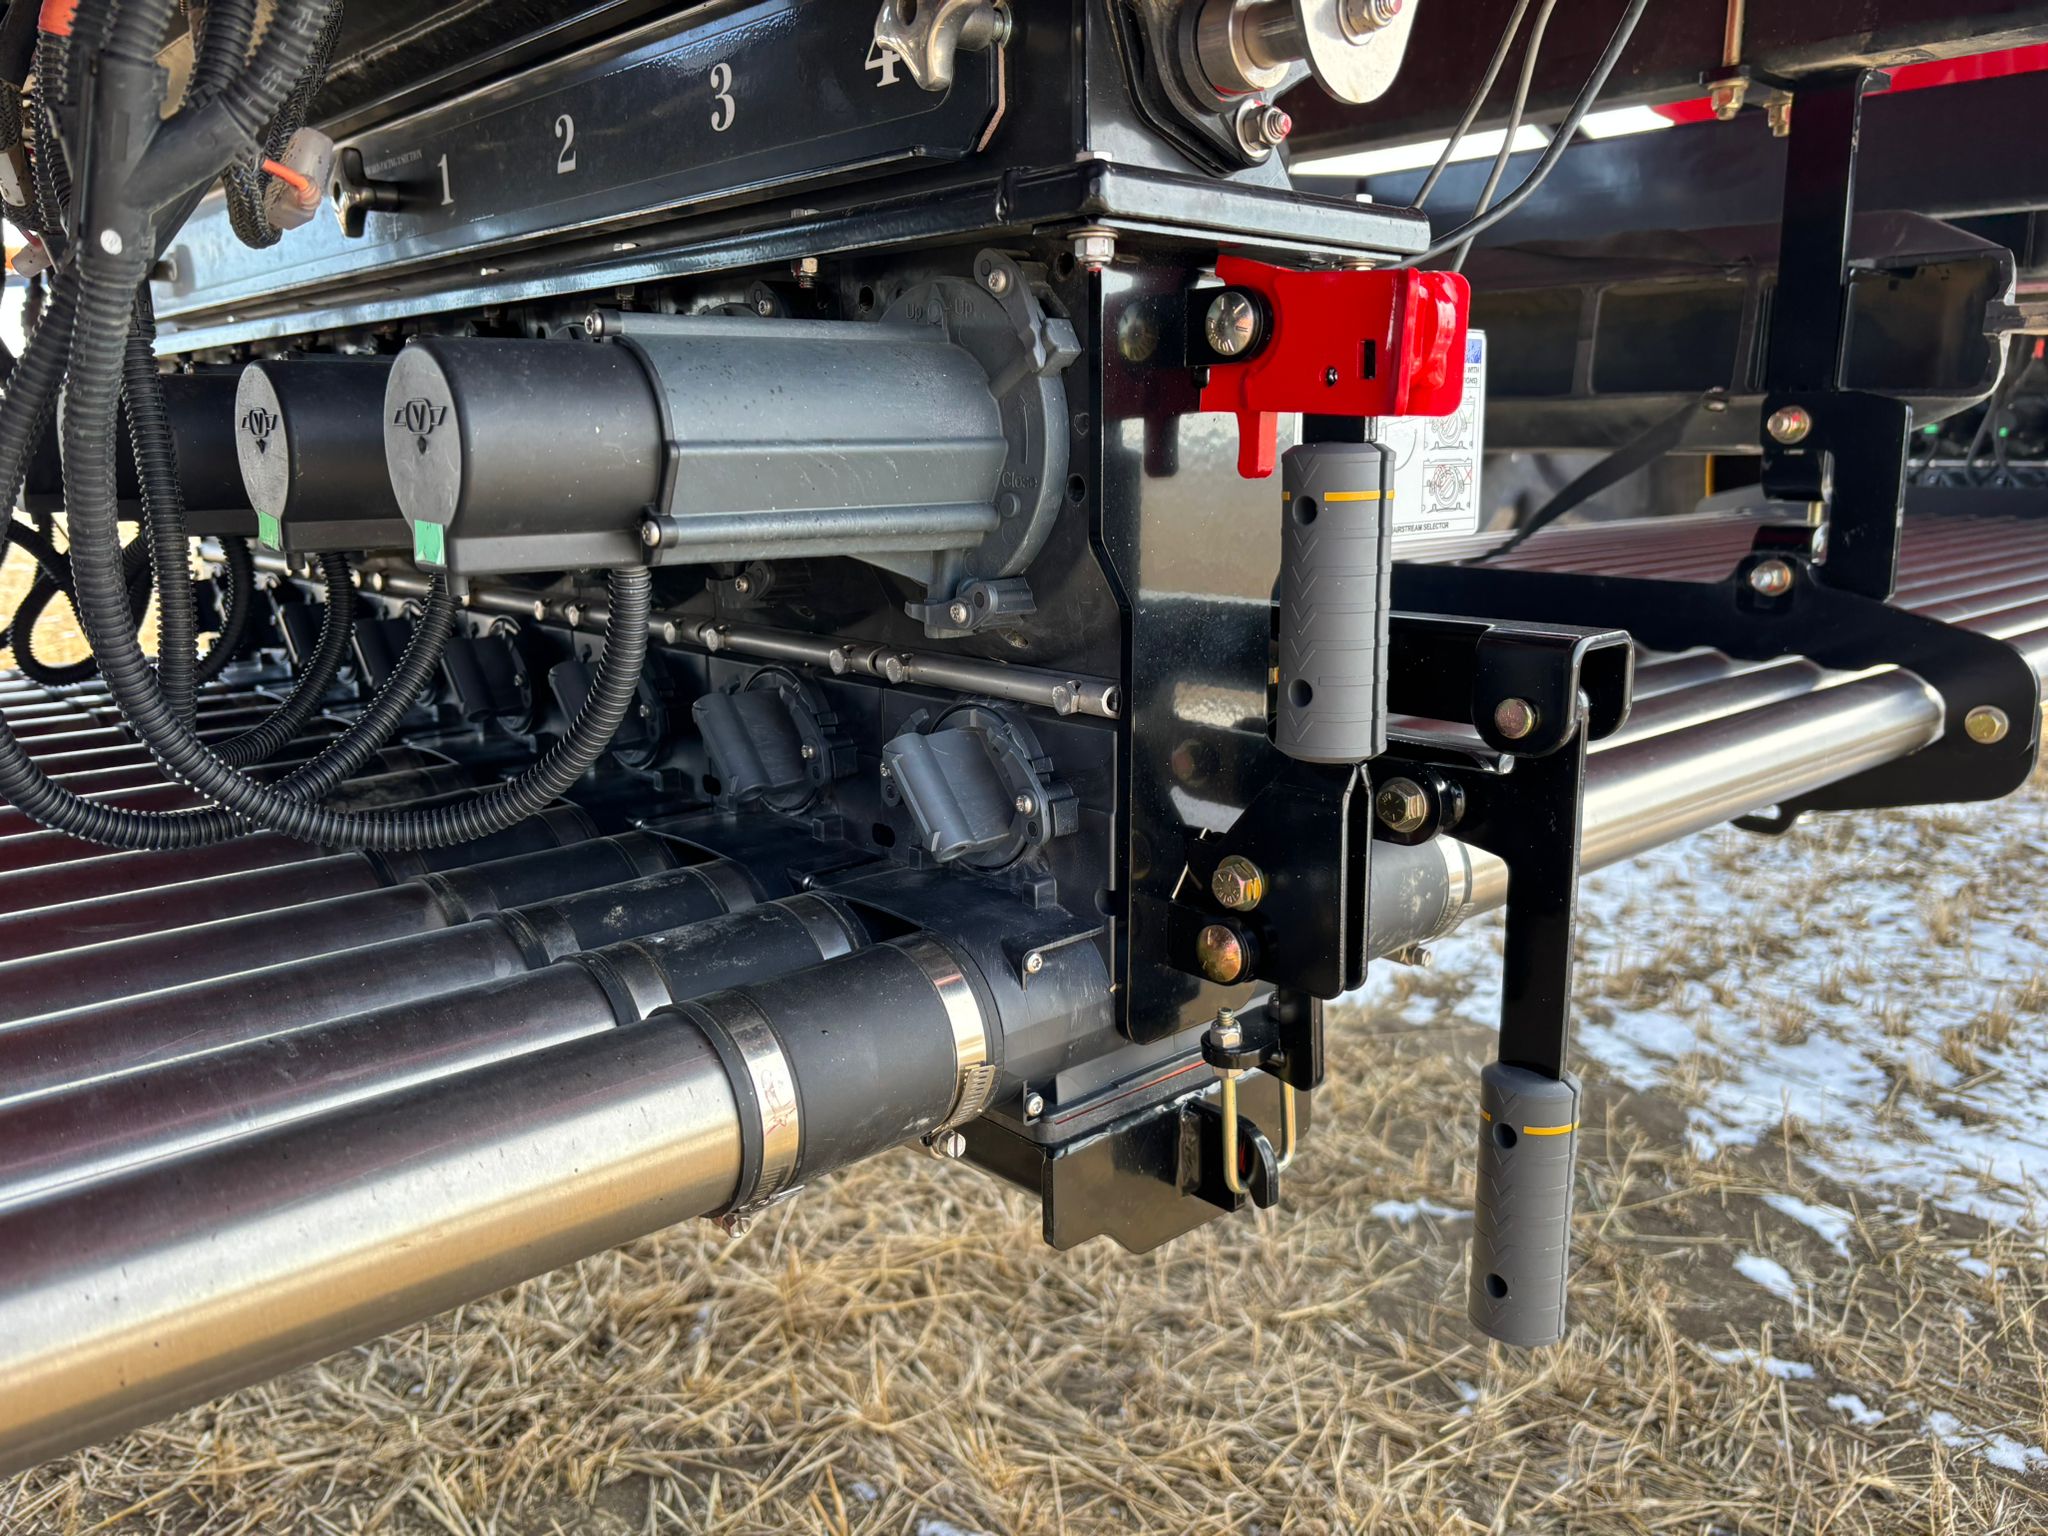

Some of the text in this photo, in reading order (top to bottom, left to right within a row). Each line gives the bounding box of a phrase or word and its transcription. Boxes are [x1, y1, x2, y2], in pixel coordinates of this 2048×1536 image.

[710, 62, 736, 132] 3
[555, 114, 577, 174] 2
[437, 153, 455, 206] 1
[1393, 522, 1449, 533] AIRSTREAM SELECTOR
